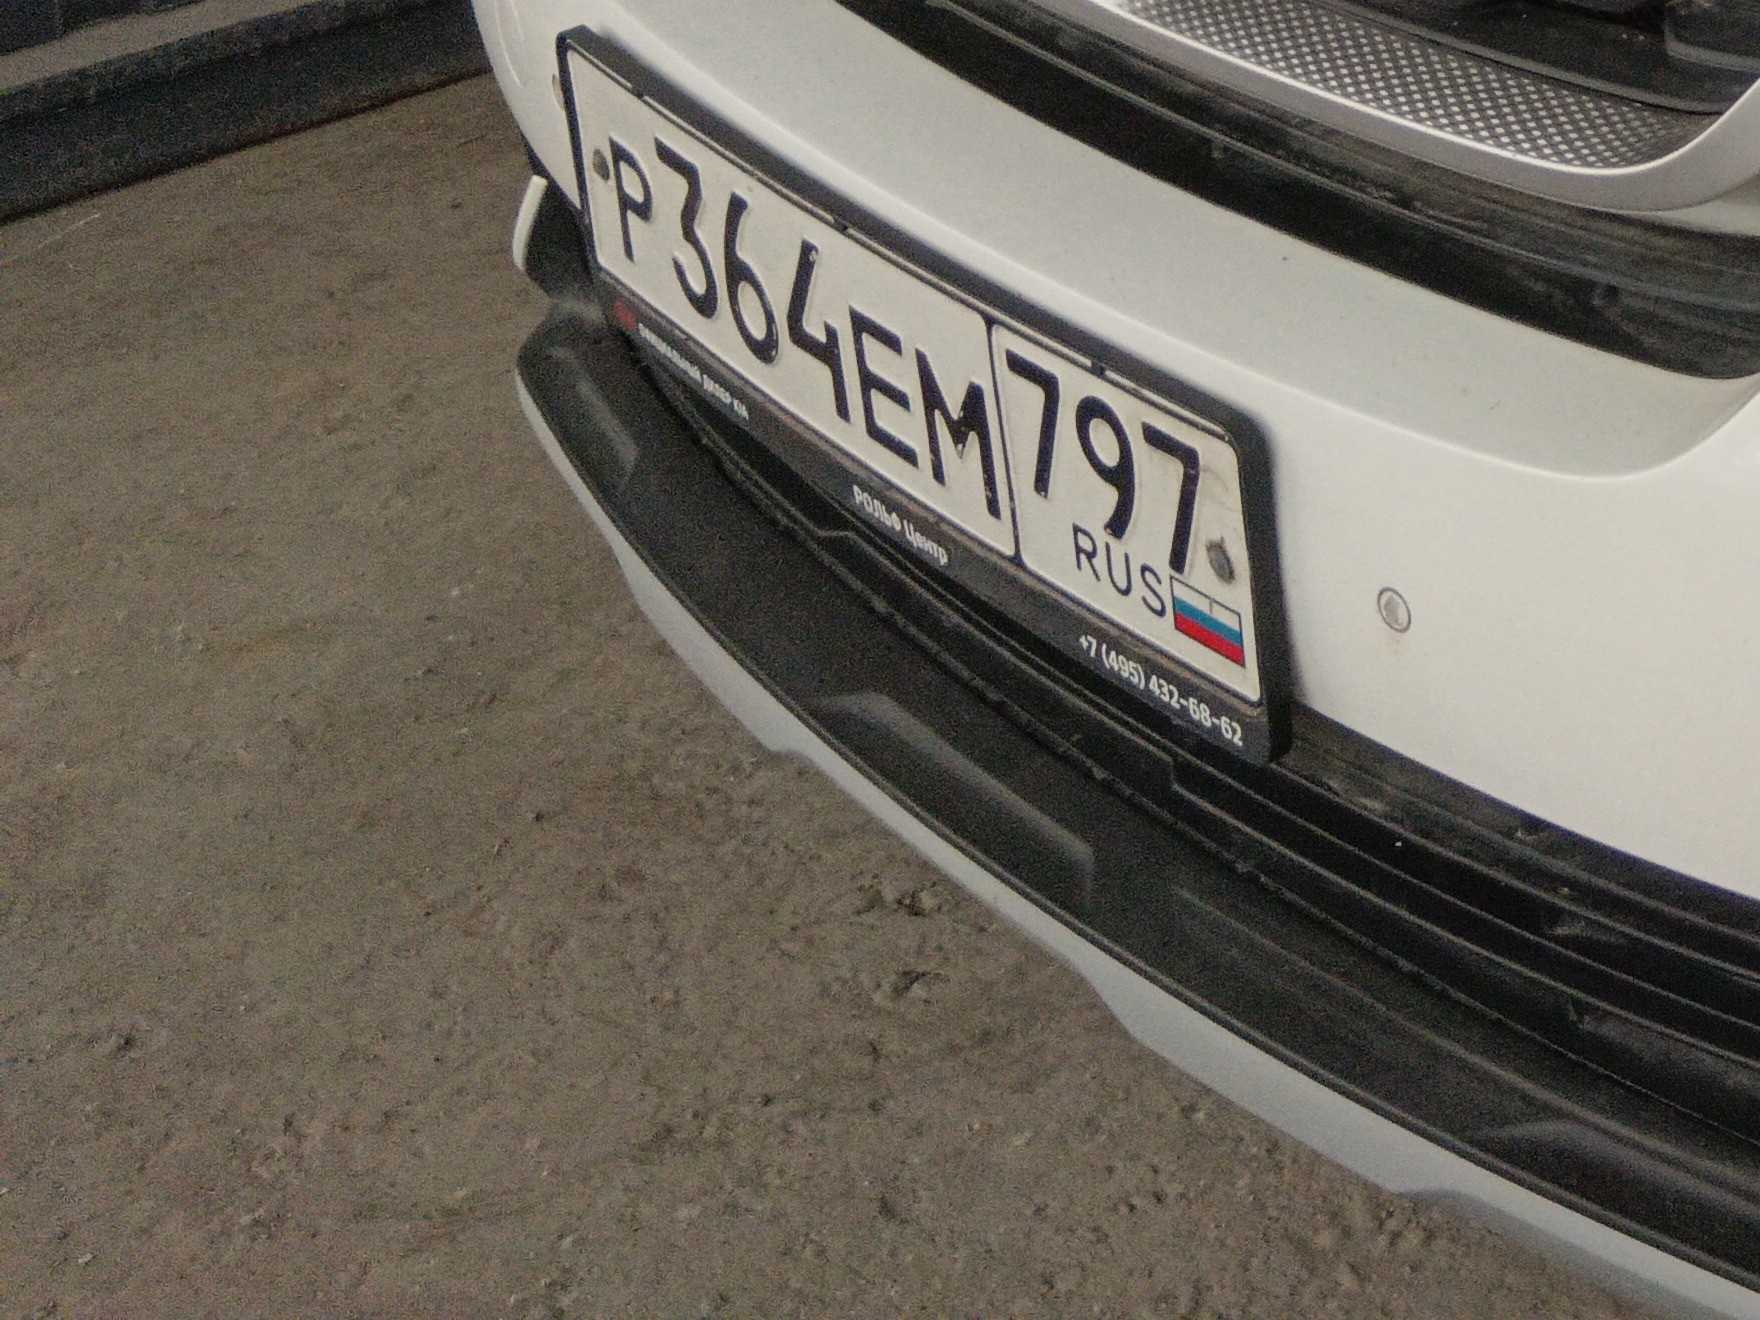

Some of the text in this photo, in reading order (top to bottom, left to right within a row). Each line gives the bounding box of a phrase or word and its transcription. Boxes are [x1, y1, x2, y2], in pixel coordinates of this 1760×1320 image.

[1004, 347, 1201, 577] 797
[1072, 521, 1167, 618] RUS
[1079, 634, 1244, 747] +7 (495) 432-68-62
